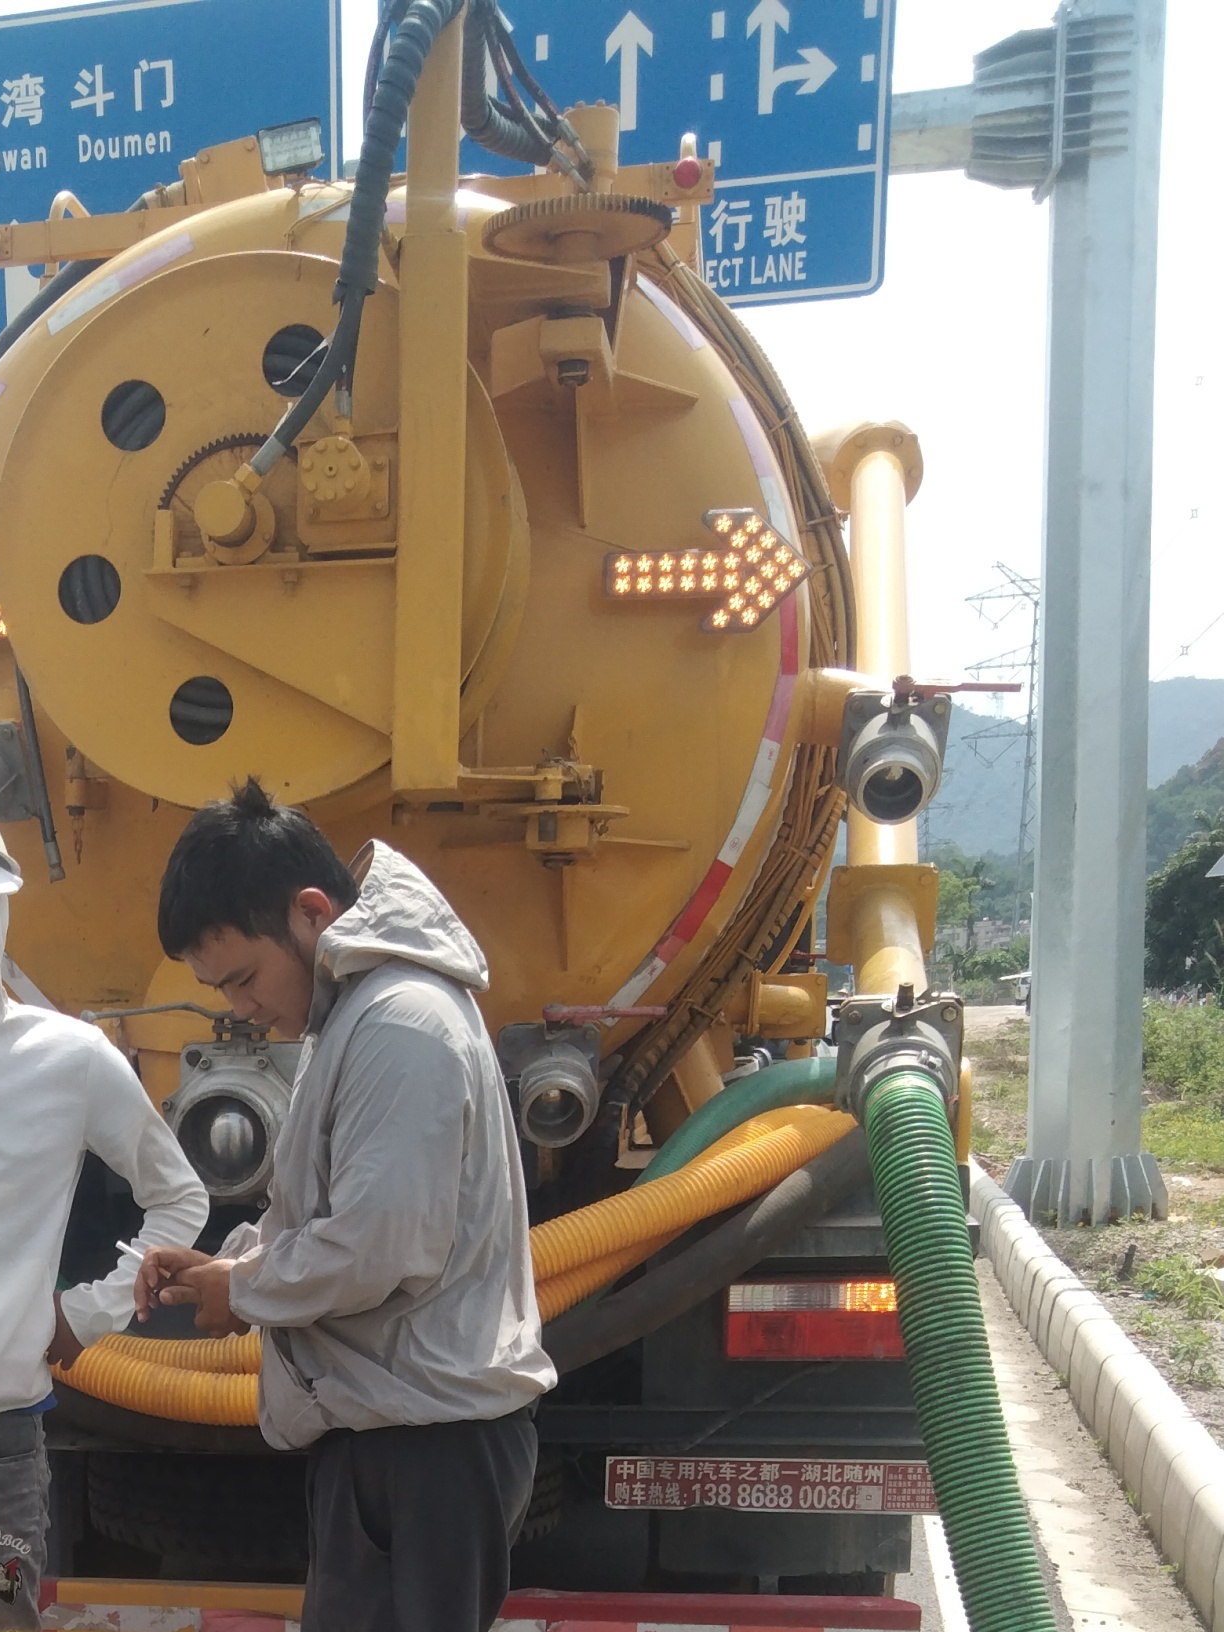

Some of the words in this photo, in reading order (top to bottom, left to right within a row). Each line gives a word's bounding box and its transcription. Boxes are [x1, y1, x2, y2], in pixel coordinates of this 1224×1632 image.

[78, 128, 172, 163] Doumen
[750, 251, 807, 286] LANE
[691, 1483, 731, 1506] 138
[737, 1484, 793, 1508] 8688
